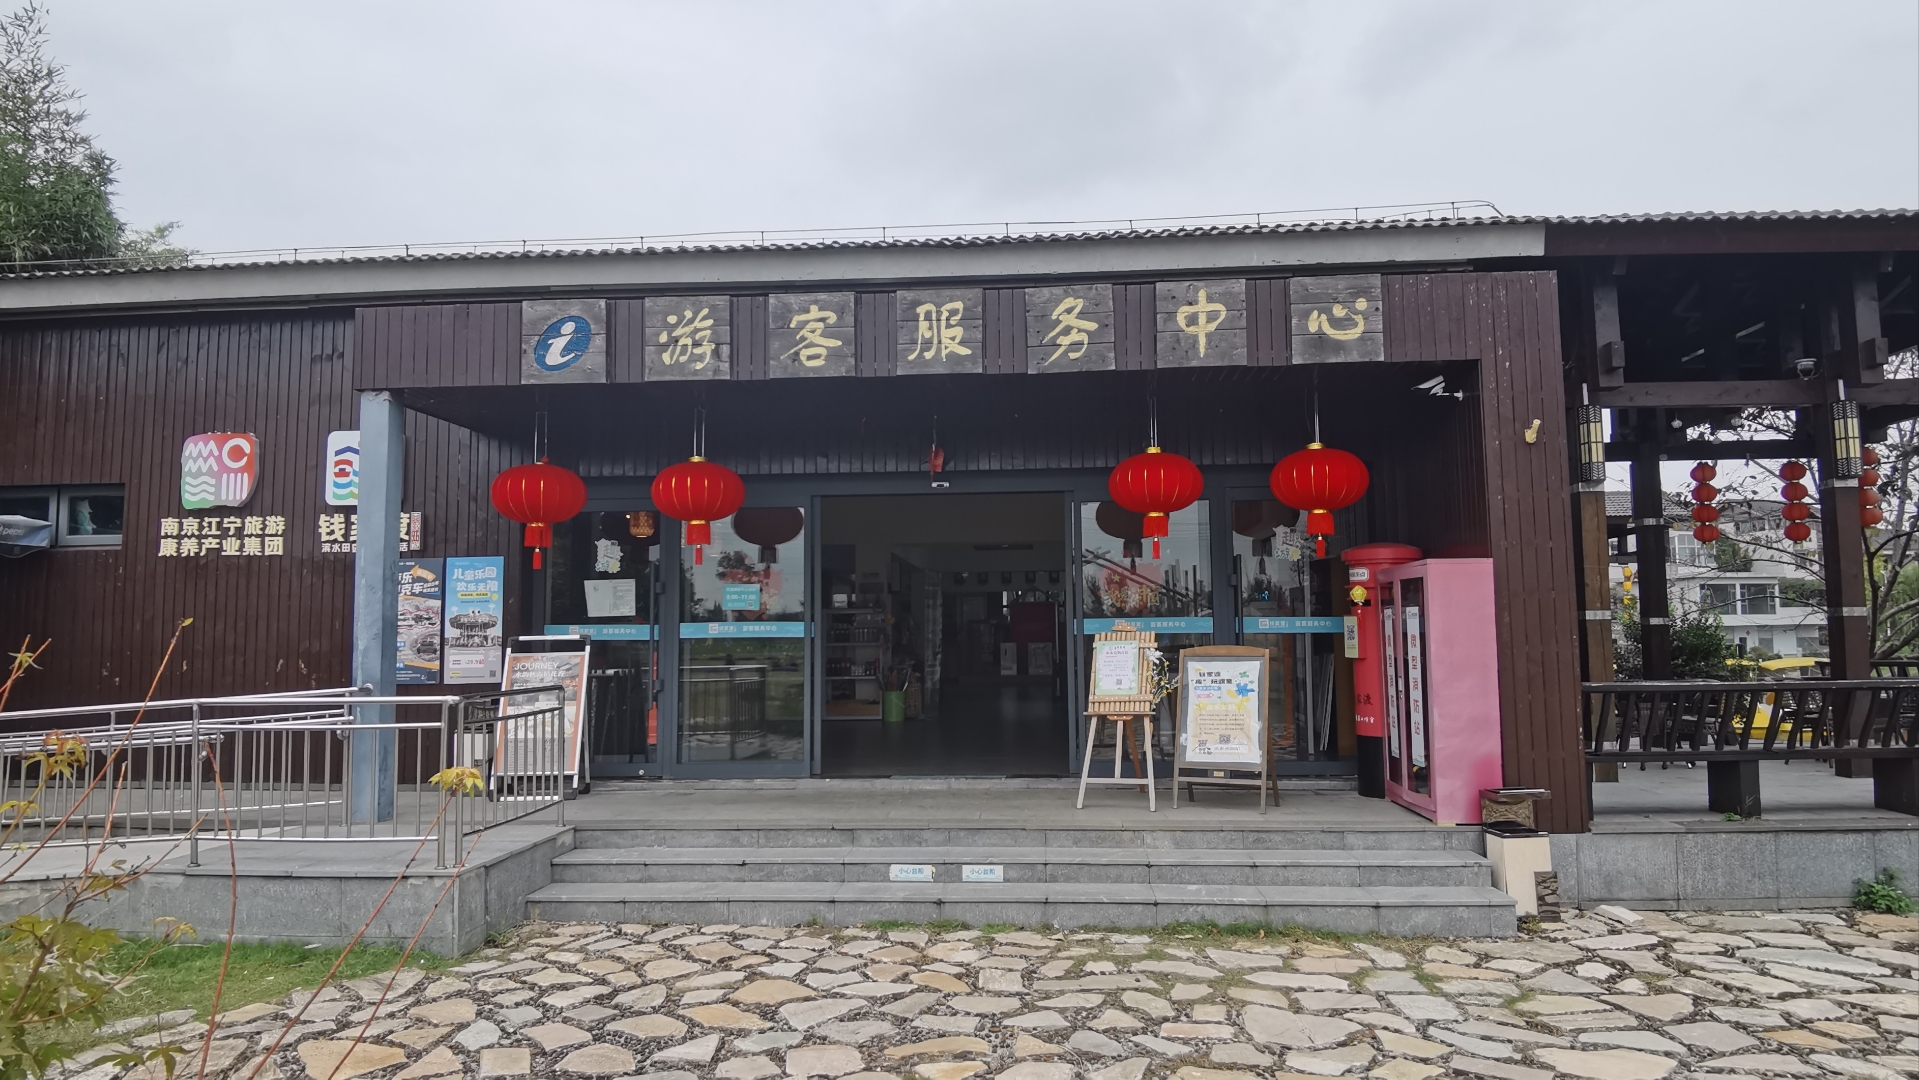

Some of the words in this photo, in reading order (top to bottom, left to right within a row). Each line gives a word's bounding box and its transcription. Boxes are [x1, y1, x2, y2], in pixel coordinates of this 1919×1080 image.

[659, 288, 1367, 370] 游客服务中心
[160, 515, 285, 536] 南京江宁旅游
[158, 536, 284, 557] 康养产业集团
[453, 566, 497, 580] 儿童乐园
[399, 583, 424, 595] 克车
[456, 580, 498, 592] 欢乐无限
[514, 661, 559, 671] JOURNEY
[1410, 633, 1421, 736] 微型消防站
[898, 867, 925, 875] 小心台阶
[969, 867, 996, 875] 小心台阶
